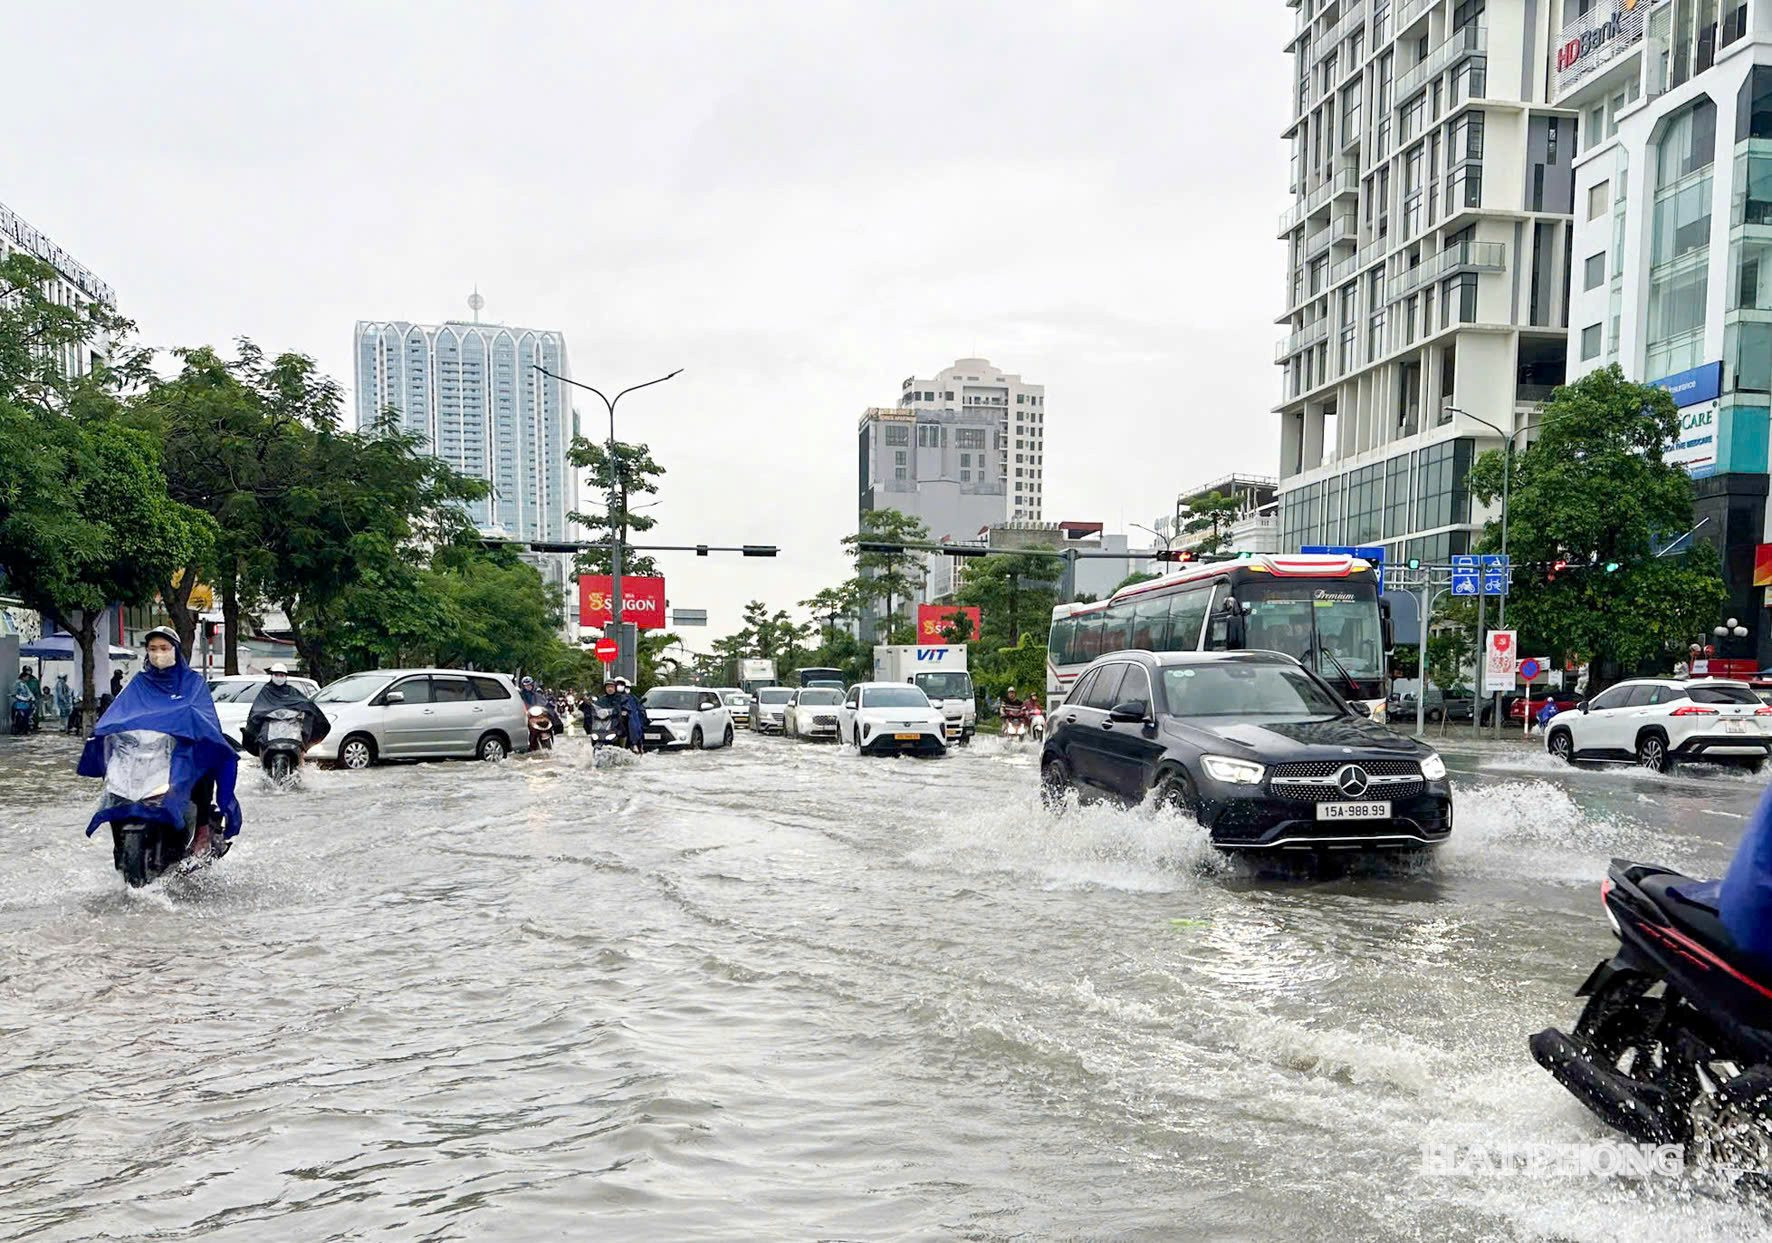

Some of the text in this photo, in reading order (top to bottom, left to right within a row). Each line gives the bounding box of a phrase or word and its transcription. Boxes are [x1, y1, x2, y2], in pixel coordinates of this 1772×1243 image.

[1555, 12, 1622, 72] HDBank
[1313, 589, 1355, 600] Premium
[604, 599, 655, 611] SIGON
[1324, 805, 1386, 818] 15A-988.99
